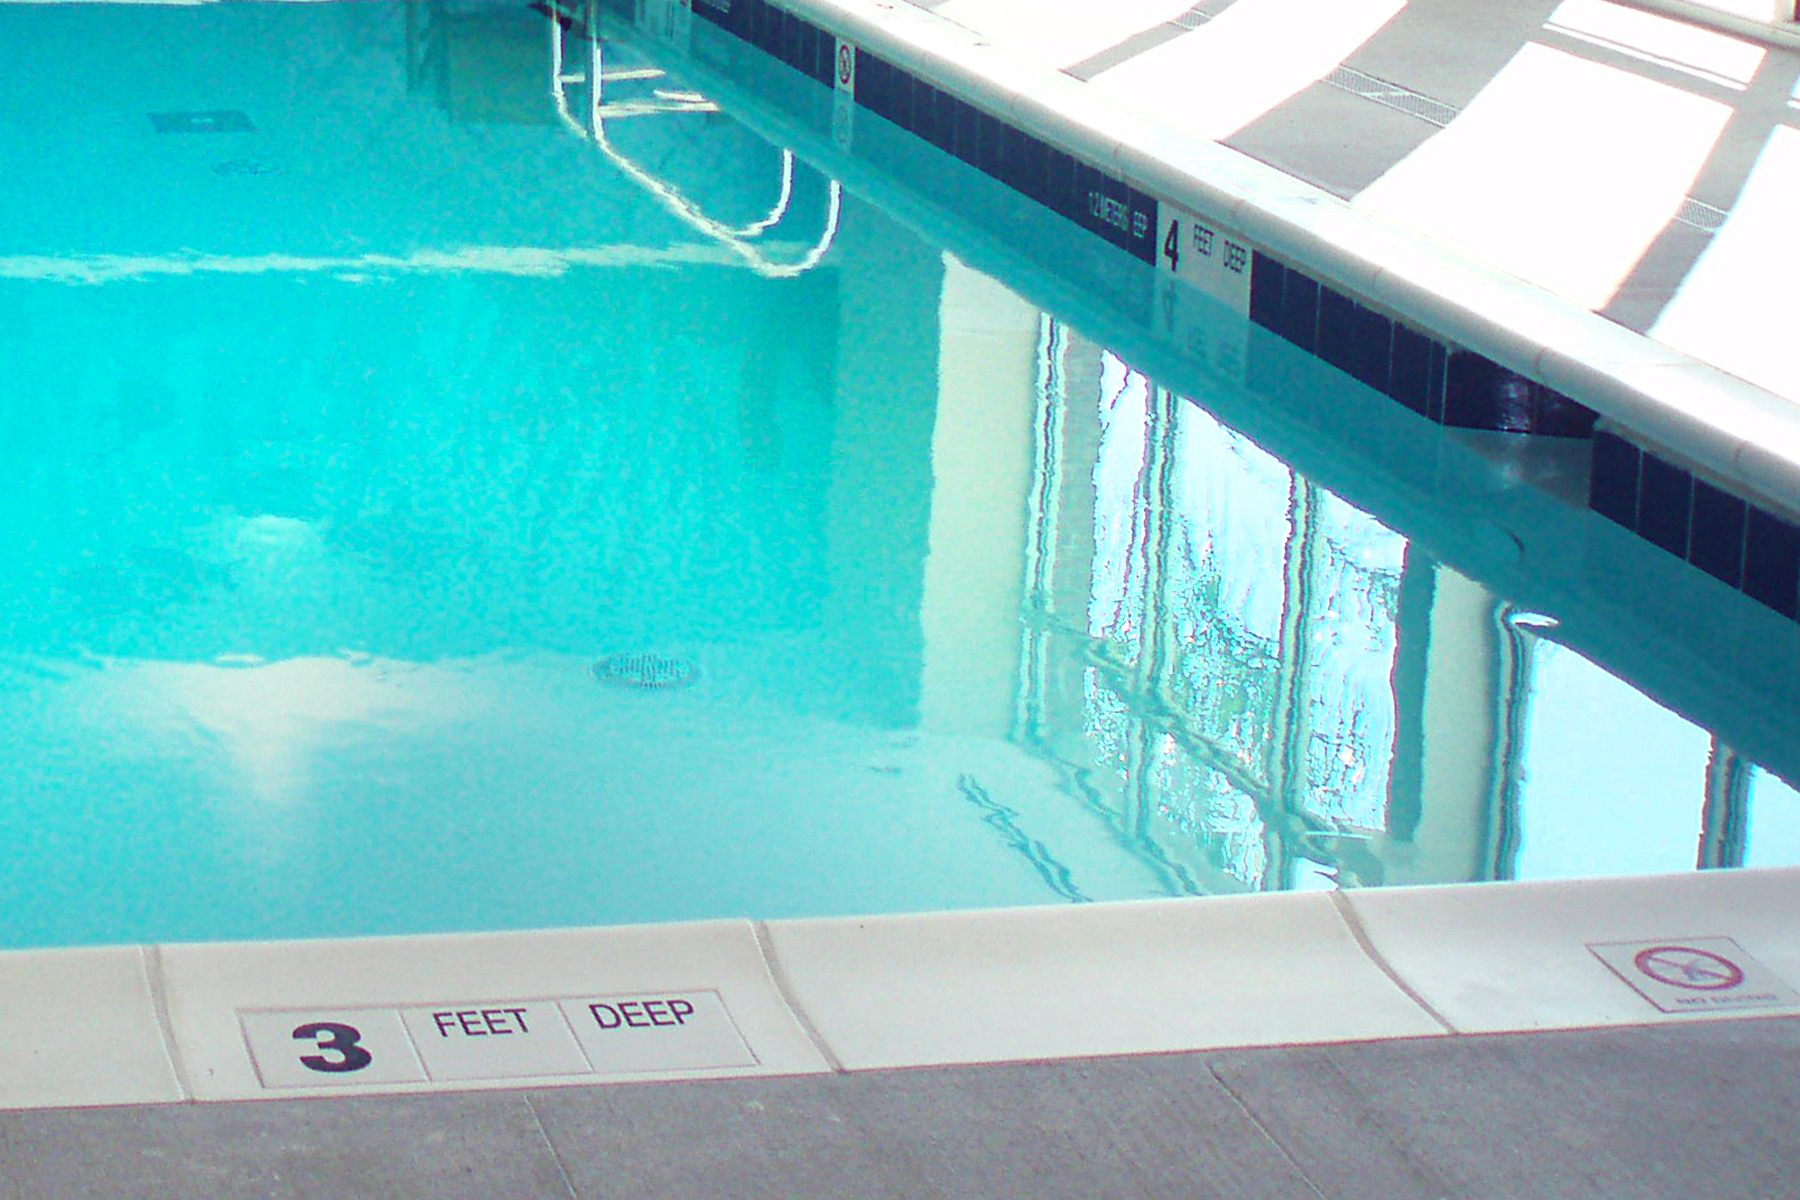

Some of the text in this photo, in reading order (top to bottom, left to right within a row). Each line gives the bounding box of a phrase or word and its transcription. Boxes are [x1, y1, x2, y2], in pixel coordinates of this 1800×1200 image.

[1164, 218, 1246, 273] 4 FEET DEEP
[292, 999, 694, 1073] 3 FEET DEEP
